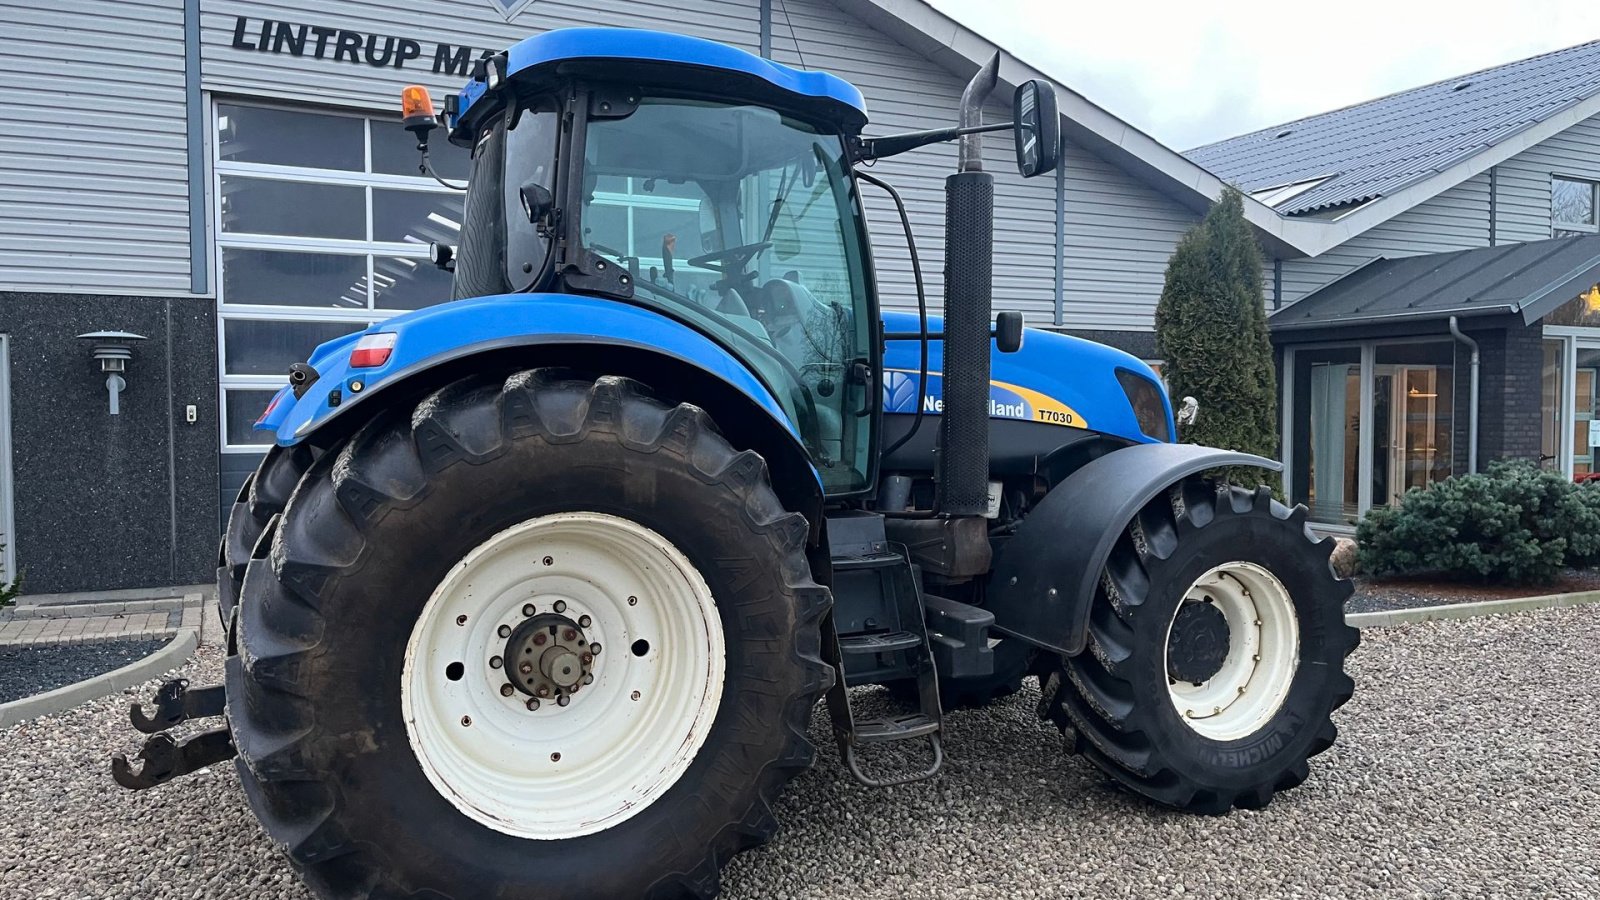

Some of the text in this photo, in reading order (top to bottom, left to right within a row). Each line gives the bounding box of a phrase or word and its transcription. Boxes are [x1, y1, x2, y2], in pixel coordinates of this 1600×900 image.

[232, 16, 421, 69] LINTRUP
[922, 395, 944, 412] Ne
[1038, 409, 1073, 424] T7030
[1198, 733, 1284, 768] MICHELIN
